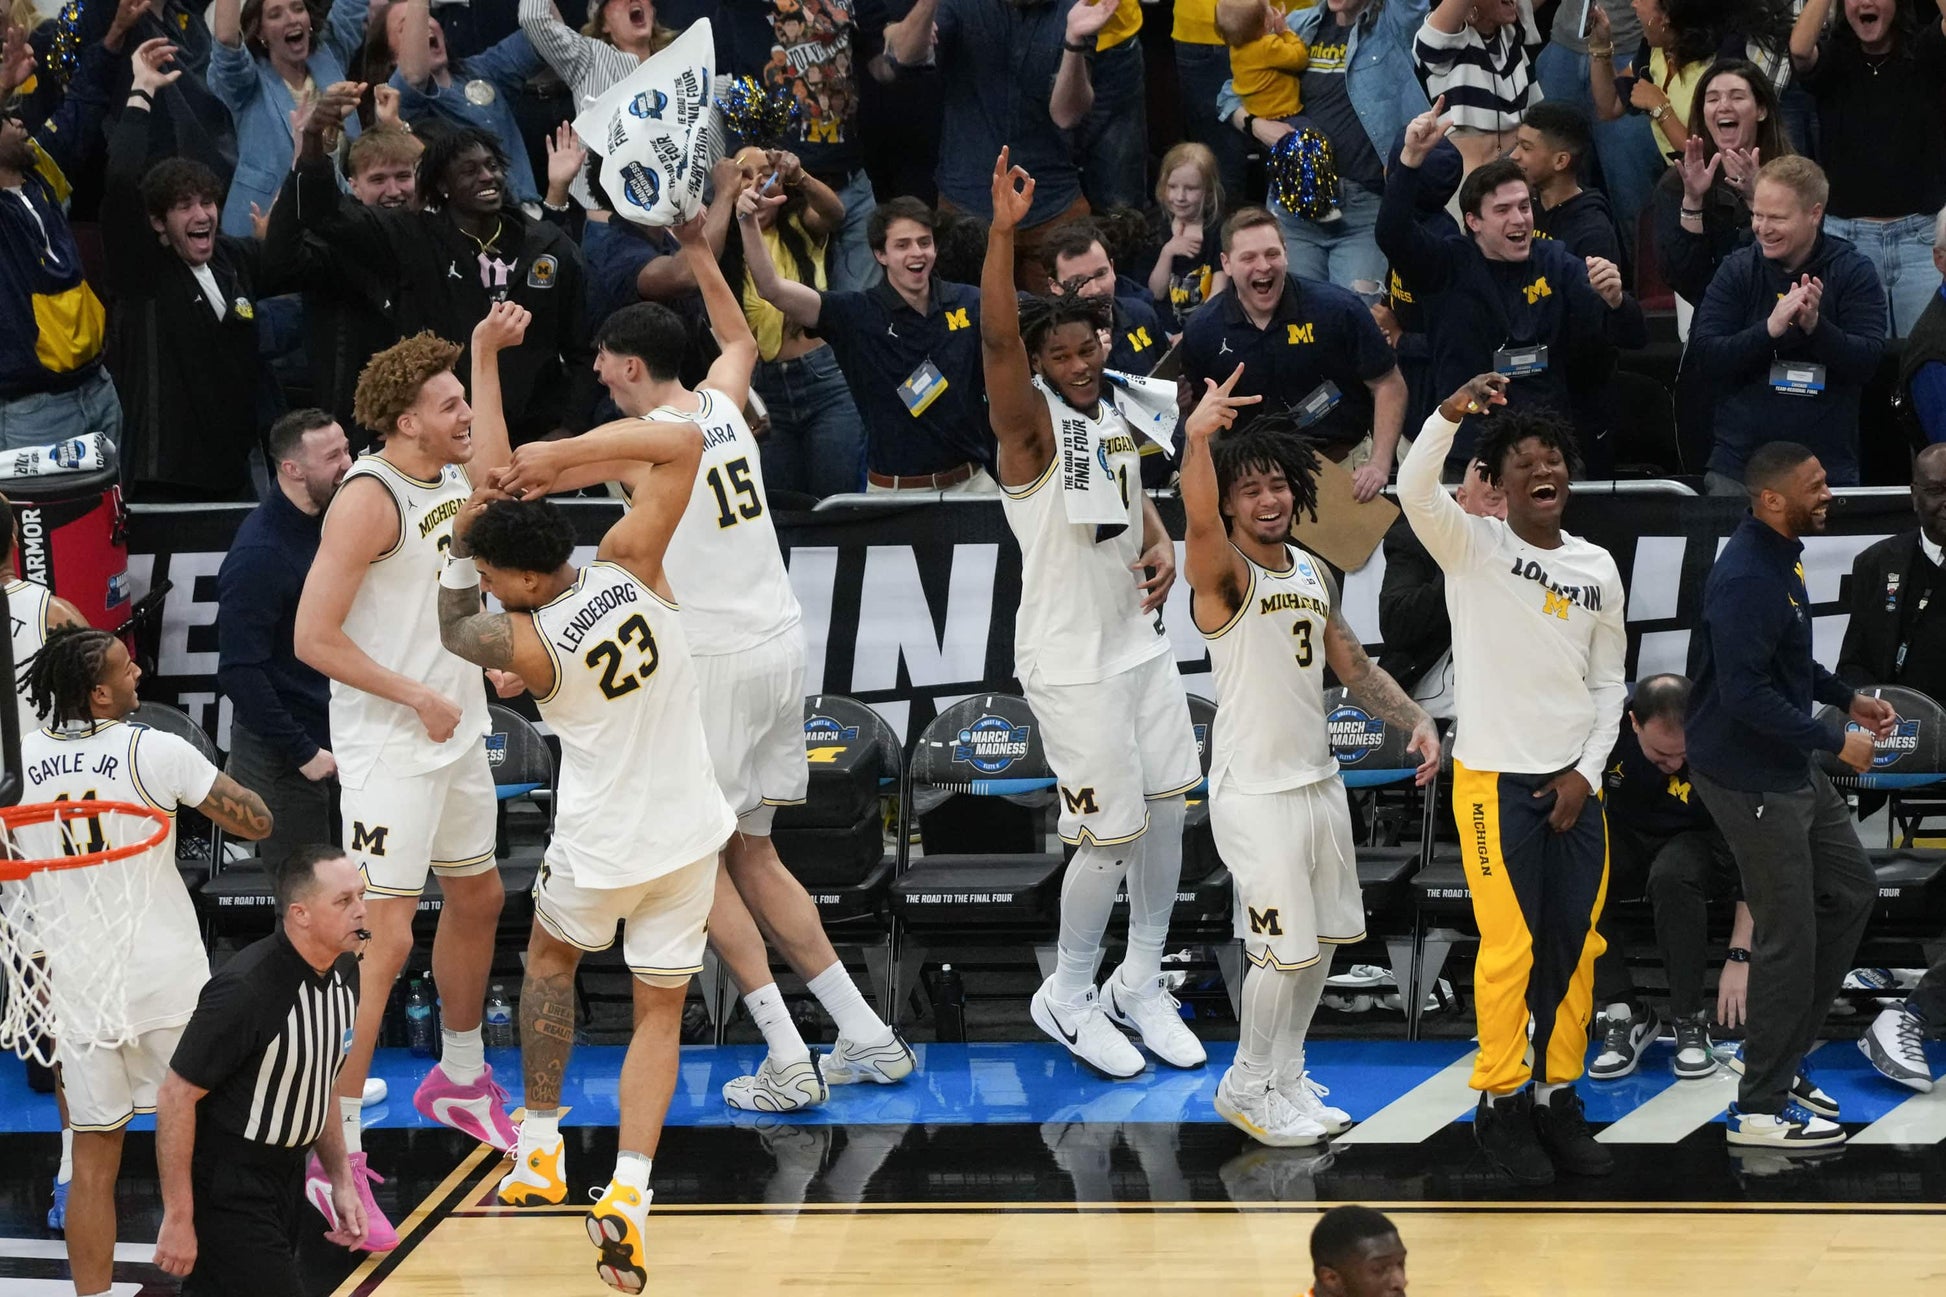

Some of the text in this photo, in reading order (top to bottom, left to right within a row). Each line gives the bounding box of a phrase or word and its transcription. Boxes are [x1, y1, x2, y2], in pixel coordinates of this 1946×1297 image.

[687, 101, 700, 128] INAL
[1523, 276, 1552, 304] M
[944, 308, 971, 331] M
[1287, 322, 1314, 344] M
[1127, 326, 1152, 352] M
[1062, 419, 1073, 490] THE ROAD TO THE
[1072, 419, 1090, 490] FINAL FOUR
[706, 456, 763, 528] 15
[22, 508, 48, 587] ARMOR
[556, 582, 638, 654] LENDEBORG
[1542, 590, 1571, 620] M
[584, 613, 659, 700] 23
[1292, 619, 1313, 668] 3
[971, 731, 1010, 742] MARCH
[1328, 721, 1366, 734] MARCH
[1332, 732, 1382, 746] MADNESS
[976, 742, 1026, 754] MADNESS
[1874, 736, 1916, 748] ADNESS
[28, 752, 118, 786] GAYLE JR.
[1060, 786, 1100, 814] M
[1667, 776, 1692, 804] M
[352, 820, 388, 856] M
[1472, 803, 1492, 876] MICHIGAN
[219, 896, 276, 906] THE ROAD TO TH
[431, 901, 440, 910] TO
[820, 895, 840, 904] FOUR
[906, 894, 1012, 903] THE ROAD TO THE FINAL FOUR
[1176, 892, 1195, 902] FOUR
[1427, 888, 1440, 898] THE
[1442, 889, 1462, 898] ROAD
[1879, 888, 1900, 897] FOUR
[1248, 906, 1283, 936] M
